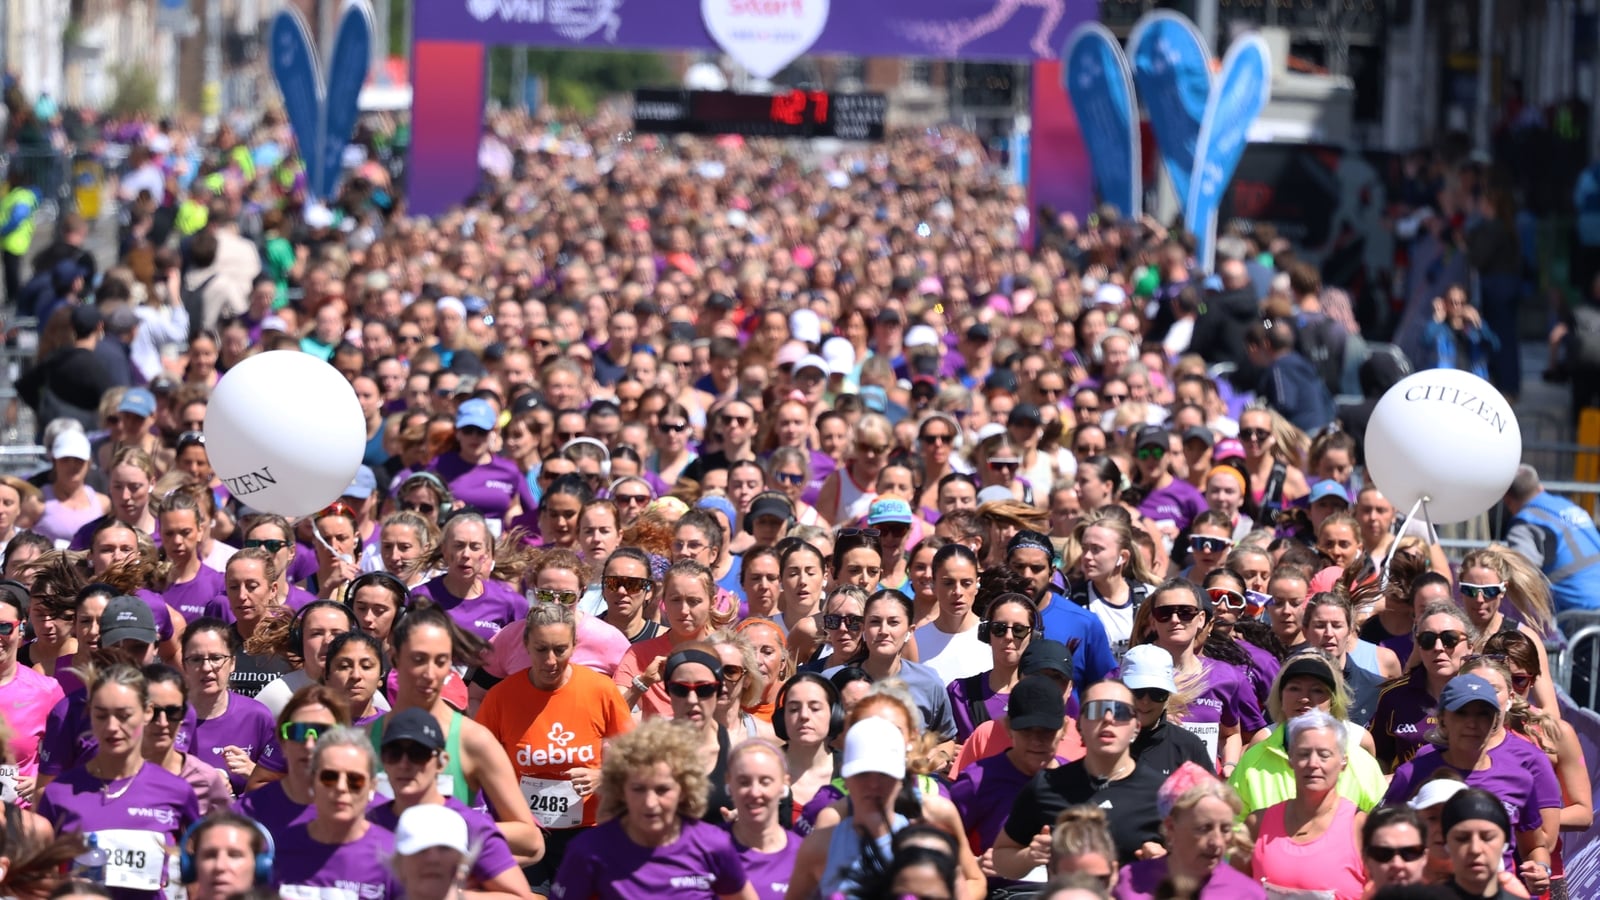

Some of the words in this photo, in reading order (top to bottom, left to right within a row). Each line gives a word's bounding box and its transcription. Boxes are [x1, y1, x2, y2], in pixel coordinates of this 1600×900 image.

[1405, 385, 1507, 434] CITIZEN
[516, 743, 595, 767] debra
[529, 794, 568, 813] 2483
[103, 848, 146, 868] 2843
